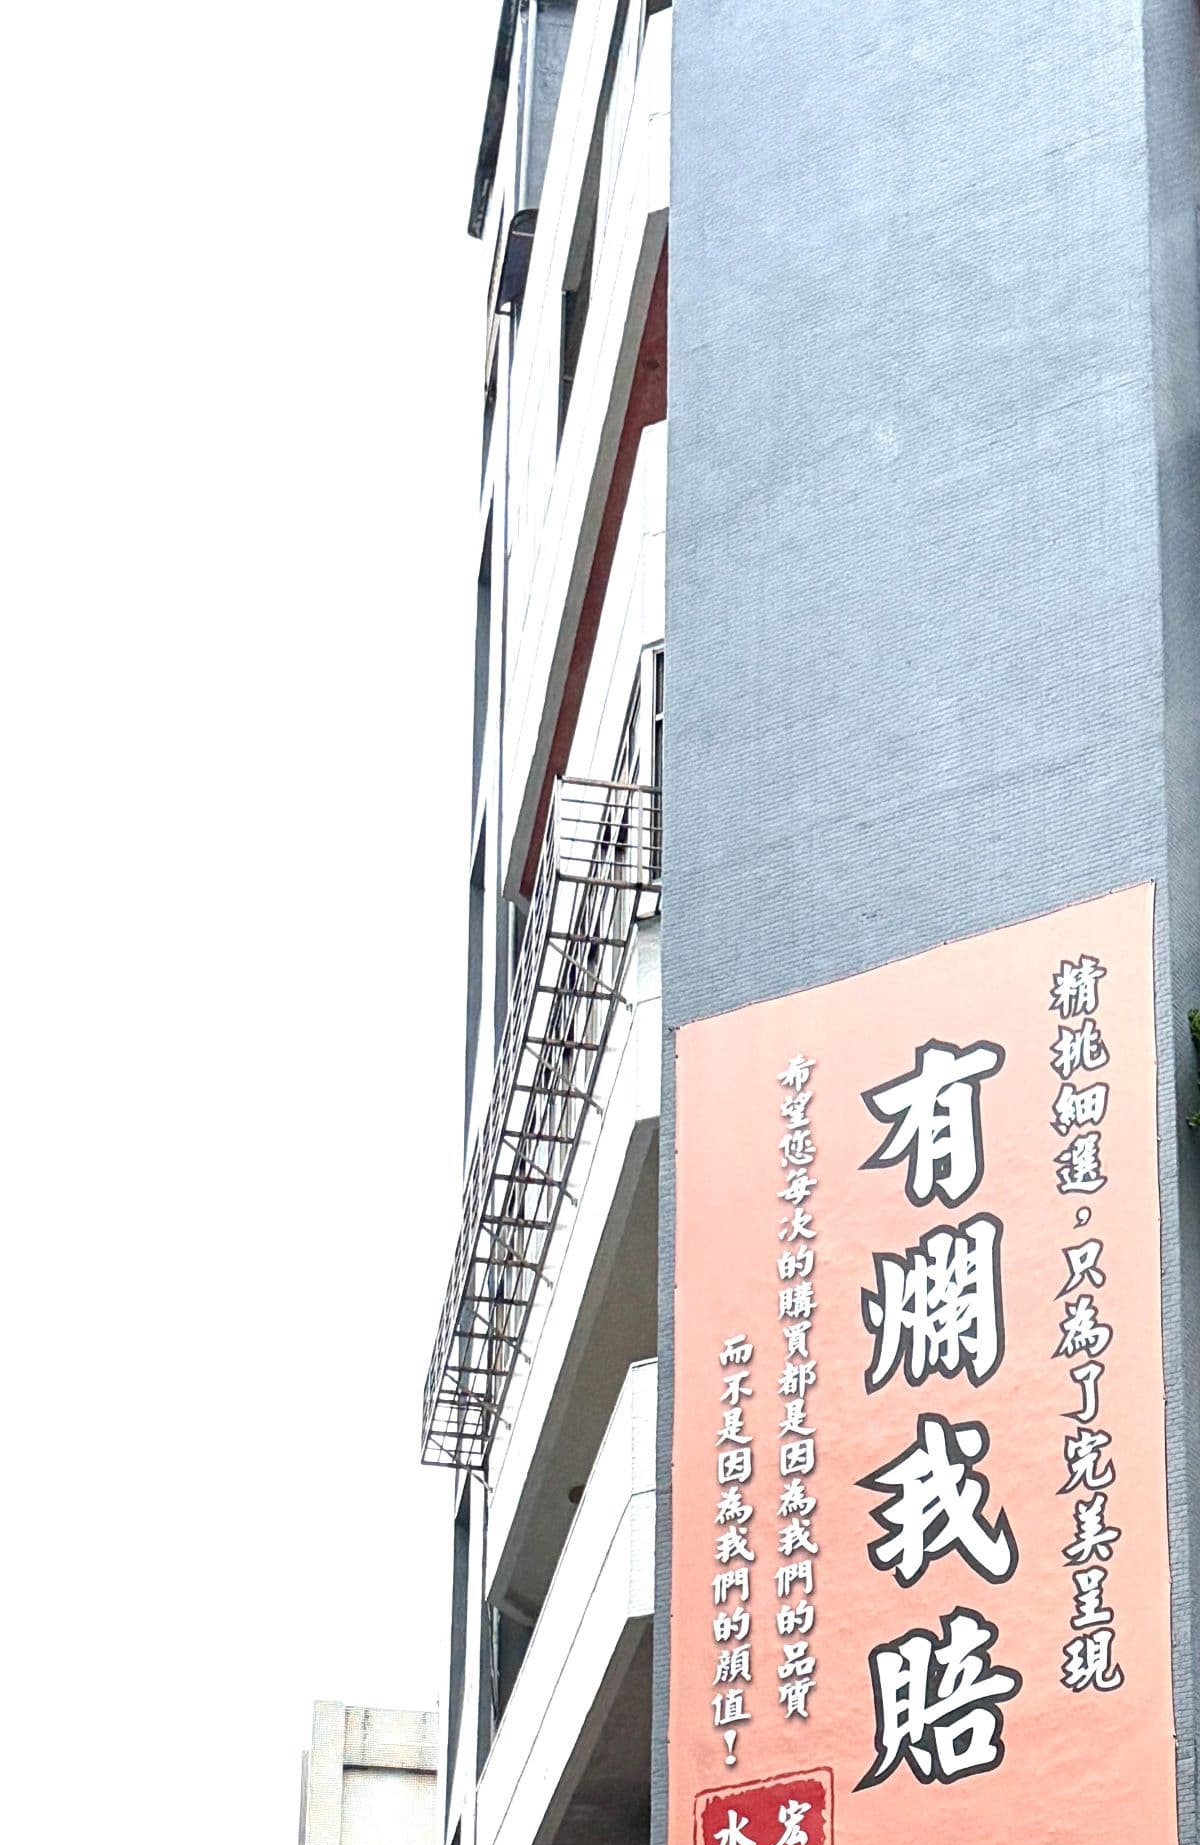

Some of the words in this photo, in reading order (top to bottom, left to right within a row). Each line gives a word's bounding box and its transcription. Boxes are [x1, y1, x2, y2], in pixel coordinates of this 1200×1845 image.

[774, 1053, 818, 1721] 希望您每次的購買都是因為我們的品質
[852, 1037, 1023, 1793] 有爛我賠
[1049, 953, 1123, 1693] 精挑細選，只為了完美呈現
